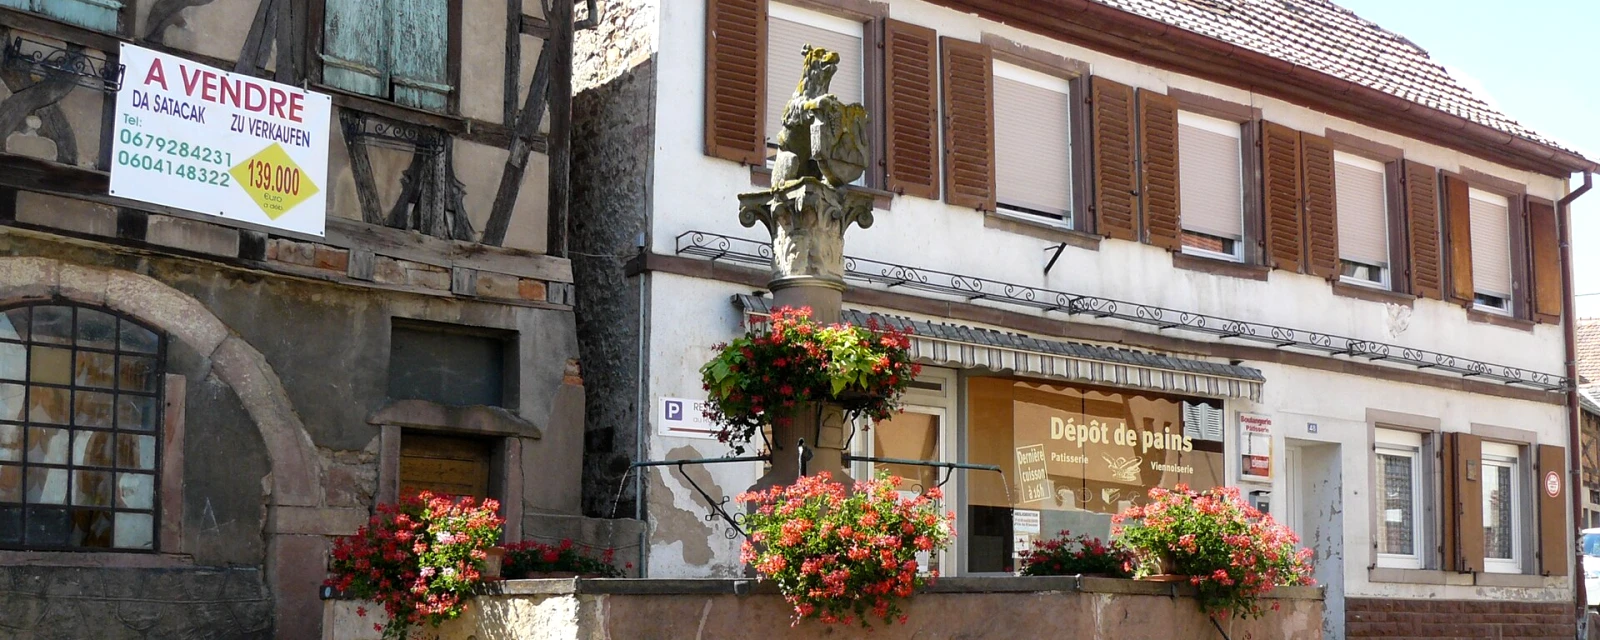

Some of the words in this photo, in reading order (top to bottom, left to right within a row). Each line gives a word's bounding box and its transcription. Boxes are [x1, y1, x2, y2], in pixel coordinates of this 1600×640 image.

[144, 57, 168, 91] A
[179, 64, 304, 123] VENDRE
[132, 89, 150, 111] DA
[153, 95, 206, 124] SATACAK
[123, 113, 143, 127] Tel:
[230, 113, 246, 133] ZU
[248, 117, 311, 148] VERKAUFEN
[120, 128, 232, 167] 0679284231
[118, 150, 230, 187] 0604148322
[248, 159, 300, 196] 139.000
[264, 192, 282, 202] Euro
[1240, 416, 1272, 426] Boulangerie
[1051, 416, 1109, 448] Dépôt
[1114, 422, 1137, 447] de
[1142, 427, 1193, 454] pains
[1018, 447, 1044, 465] Dernière
[1051, 452, 1089, 464] Patisserie
[1022, 467, 1046, 483] cuisson
[1150, 461, 1194, 475] Viennoiserie
[1028, 485, 1033, 500] à
[1033, 483, 1045, 498] 16h
